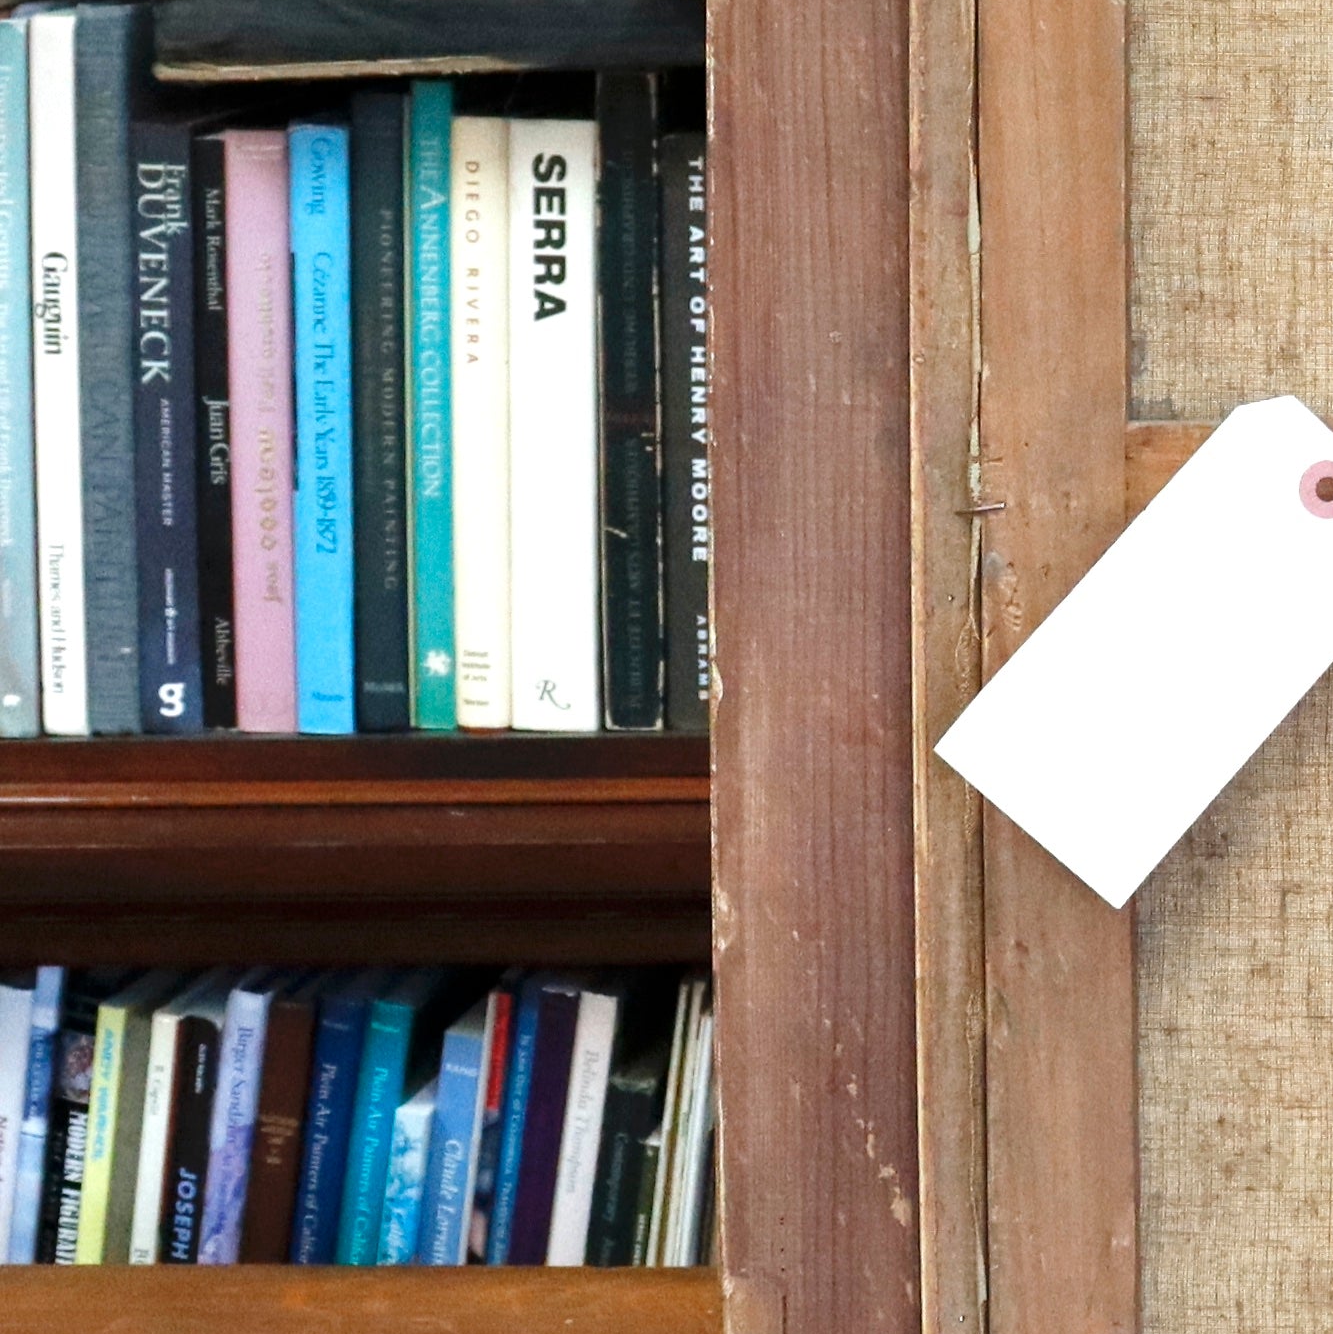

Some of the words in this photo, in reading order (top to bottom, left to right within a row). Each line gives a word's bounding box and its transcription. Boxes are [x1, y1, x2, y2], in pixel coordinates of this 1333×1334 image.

[305, 137, 333, 216] Gowing
[420, 137, 441, 179] THE
[688, 156, 705, 212] THE
[163, 163, 190, 235] Frank
[206, 187, 223, 231] Mark
[465, 160, 480, 245] DIEGO
[419, 185, 447, 343] ANNENBERG
[531, 152, 567, 322] SERRA
[688, 226, 705, 282] ART
[35, 251, 69, 356] Gauguin
[137, 162, 172, 384] DUVENECK
[206, 235, 224, 312] Rosenthal
[465, 267, 481, 365] RIVERA
[689, 296, 706, 333] OF
[313, 343, 336, 373] The
[203, 394, 230, 441] Juan
[379, 367, 396, 466] MODERN
[419, 352, 443, 499] COLLECTION
[690, 345, 708, 444] HENRY
[160, 397, 174, 467] AMERICAN
[209, 442, 230, 486] Gris
[313, 427, 336, 471] Years
[161, 471, 175, 527] MASTER
[691, 458, 708, 562] MOORE
[383, 479, 398, 590] PAINTING
[49, 543, 65, 603] Thames
[50, 605, 63, 633] and
[214, 617, 232, 686] Abbeville
[696, 614, 710, 701] ABRAMS
[317, 1063, 336, 1100] Plein
[371, 1066, 389, 1103] Plein
[64, 1110, 88, 1182] MODERN
[315, 1103, 332, 1127] Air
[367, 1106, 383, 1129] Air
[306, 1134, 328, 1191] Painters
[360, 1137, 380, 1192] Painters
[440, 1138, 462, 1200] Claude
[171, 1167, 198, 1261] JOSEPH
